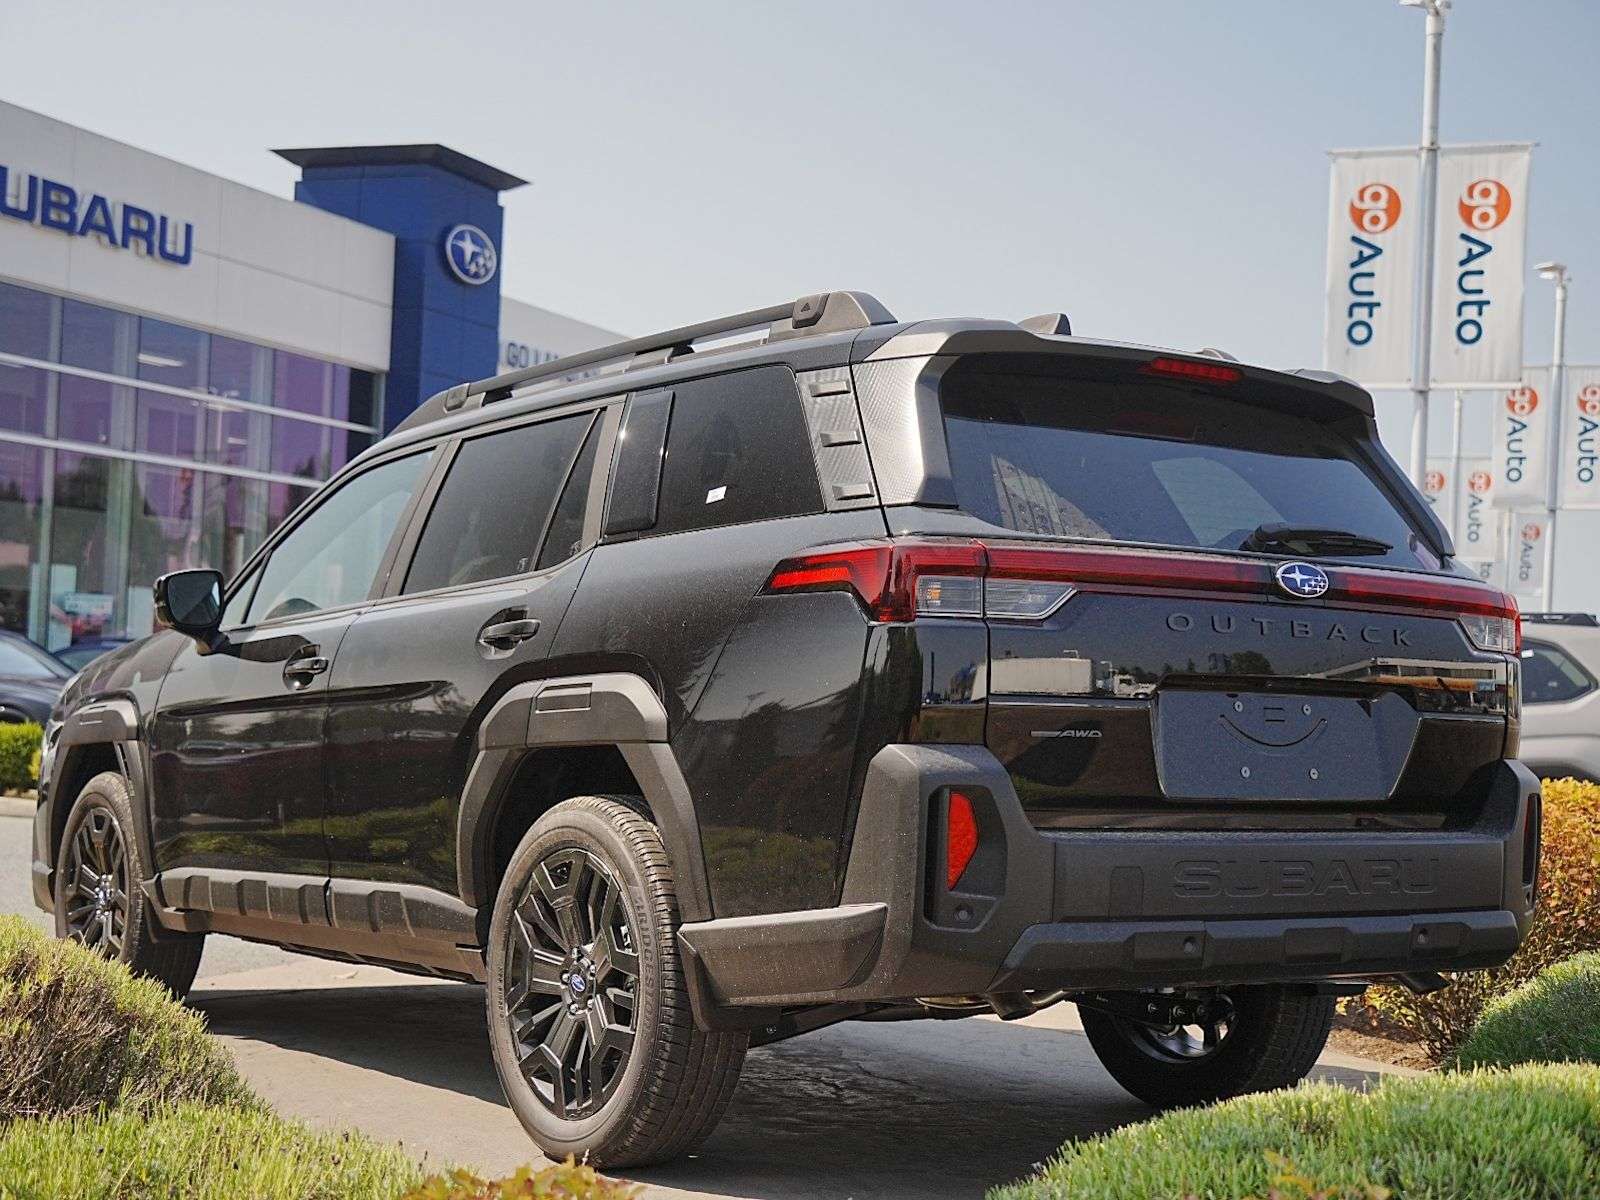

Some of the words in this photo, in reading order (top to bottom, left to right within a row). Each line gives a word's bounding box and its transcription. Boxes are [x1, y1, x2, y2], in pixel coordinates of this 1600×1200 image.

[0, 164, 193, 266] UBARU
[1347, 235, 1383, 346] Auto
[1456, 232, 1493, 345] Auto
[1506, 416, 1528, 483] Auto
[1577, 416, 1599, 483] Auto
[1467, 492, 1483, 543] Auto
[1166, 611, 1413, 647] OUTBACK
[1060, 729, 1103, 738] AWD
[1173, 858, 1440, 898] SUBARU
